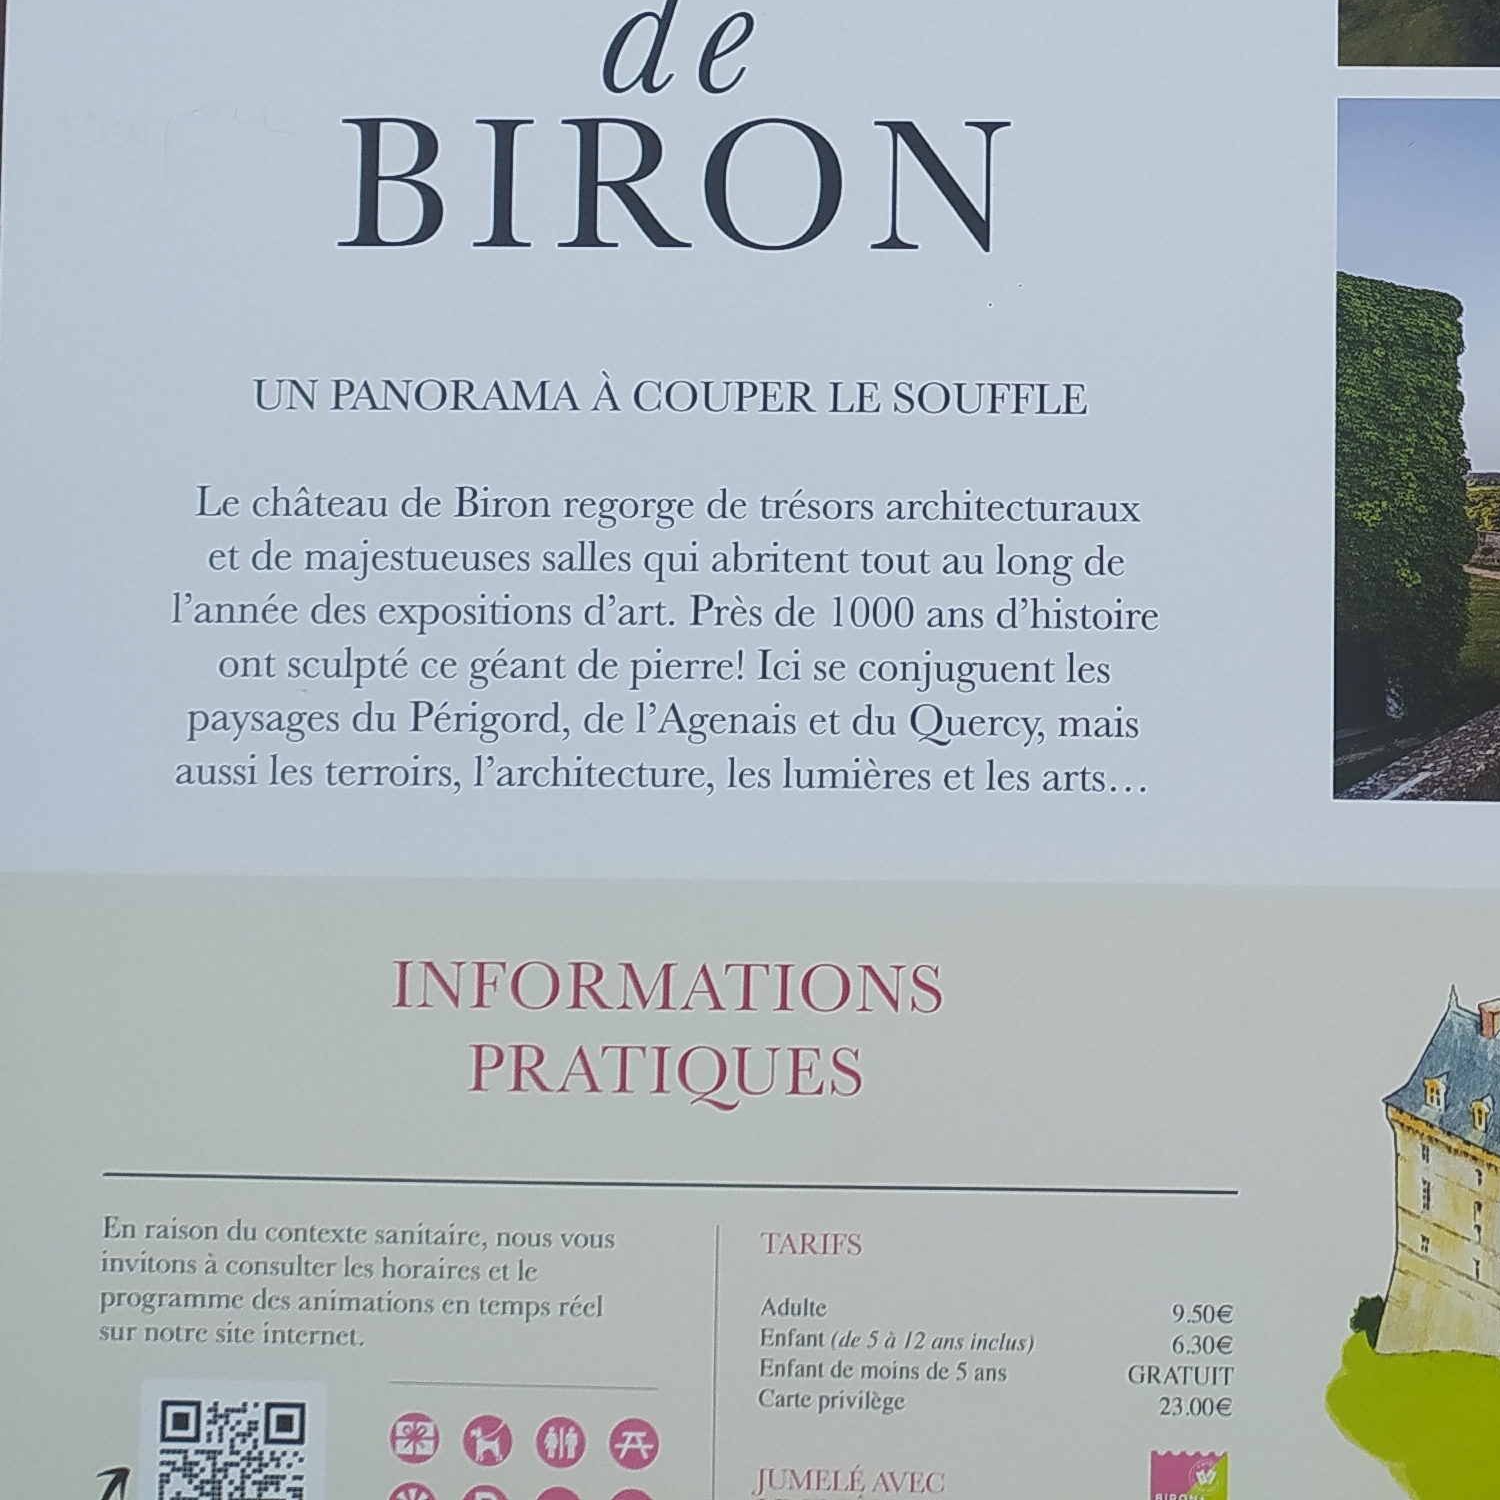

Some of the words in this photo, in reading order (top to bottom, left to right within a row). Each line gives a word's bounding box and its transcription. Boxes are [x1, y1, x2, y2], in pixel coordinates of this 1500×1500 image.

[337, 117, 1012, 253] BIRON
[253, 378, 319, 411] UN
[330, 378, 581, 411] PANORAMA
[590, 370, 622, 412] À
[633, 380, 817, 413] COUPER
[828, 381, 881, 413] LE
[893, 381, 1088, 415] SOUFFLE
[195, 485, 240, 517] Le
[252, 485, 388, 518] château
[401, 485, 442, 518] de
[453, 485, 551, 519] Biron
[563, 497, 694, 530] regorge
[706, 487, 747, 520] de
[760, 488, 874, 521] trésors
[886, 489, 1141, 523] architecturaux
[208, 546, 240, 571] et
[251, 538, 292, 571] de
[304, 539, 530, 581] majestueuses
[542, 540, 632, 572] salles
[643, 540, 699, 583] qui
[711, 540, 850, 574] abritent
[860, 549, 931, 575] tout
[942, 553, 984, 575] au
[995, 543, 1074, 586] long
[1084, 544, 1125, 577] de
[175, 753, 257, 786] aussi
[269, 753, 313, 786] les
[325, 754, 461, 795] terroirs,
[473, 754, 714, 796] l'architecture,
[727, 756, 771, 789] les
[782, 756, 931, 791] lumières
[943, 765, 975, 791] et
[985, 758, 1030, 792] les
[1042, 766, 1146, 793] arts...
[392, 960, 942, 1014] INFORMATIONS
[468, 1043, 862, 1111] PRATIQUES
[103, 1215, 136, 1239] En
[145, 1216, 219, 1241] raison
[226, 1218, 257, 1242] du
[265, 1225, 367, 1244] contexte
[374, 1221, 488, 1251] sanitaire,
[496, 1231, 553, 1248] nous
[560, 1232, 615, 1249] vous
[760, 1232, 862, 1256] TARIFS
[101, 1249, 197, 1274] invitons
[204, 1252, 219, 1275] à
[225, 1253, 338, 1277] consulter
[344, 1254, 374, 1278] les
[381, 1256, 481, 1281] horaires
[488, 1263, 509, 1281] et
[518, 1258, 538, 1282] le
[100, 1291, 244, 1315] programme
[251, 1286, 291, 1311] des
[297, 1288, 435, 1314] animations
[441, 1298, 470, 1315] en
[479, 1297, 551, 1321] temps
[559, 1294, 603, 1318] réel
[760, 1297, 827, 1318] Adulte
[1172, 1303, 1234, 1324] 9.50€
[99, 1325, 138, 1341] sur
[144, 1325, 208, 1343] notre
[215, 1320, 255, 1344] site
[263, 1321, 364, 1347] internet.
[760, 1327, 824, 1348] Enfant
[830, 1329, 862, 1351] (de
[866, 1330, 879, 1349] 5
[884, 1331, 897, 1349] à
[904, 1330, 926, 1350] 12
[931, 1336, 963, 1351] ans
[970, 1332, 1035, 1355] inclus)
[1172, 1334, 1233, 1355] 6.30€
[760, 1357, 824, 1379] Enfant
[830, 1359, 854, 1379] de
[860, 1360, 920, 1380] moins
[926, 1361, 949, 1381] de
[956, 1361, 967, 1381] 5
[974, 1367, 1007, 1382] ans
[1128, 1364, 1235, 1386] GRATUIT
[758, 1388, 812, 1409] Carte
[818, 1389, 905, 1416] privilège
[1159, 1396, 1232, 1417] 23.00€
[753, 1465, 866, 1495] JUMELÉ
[872, 1471, 945, 1494] AVEC
